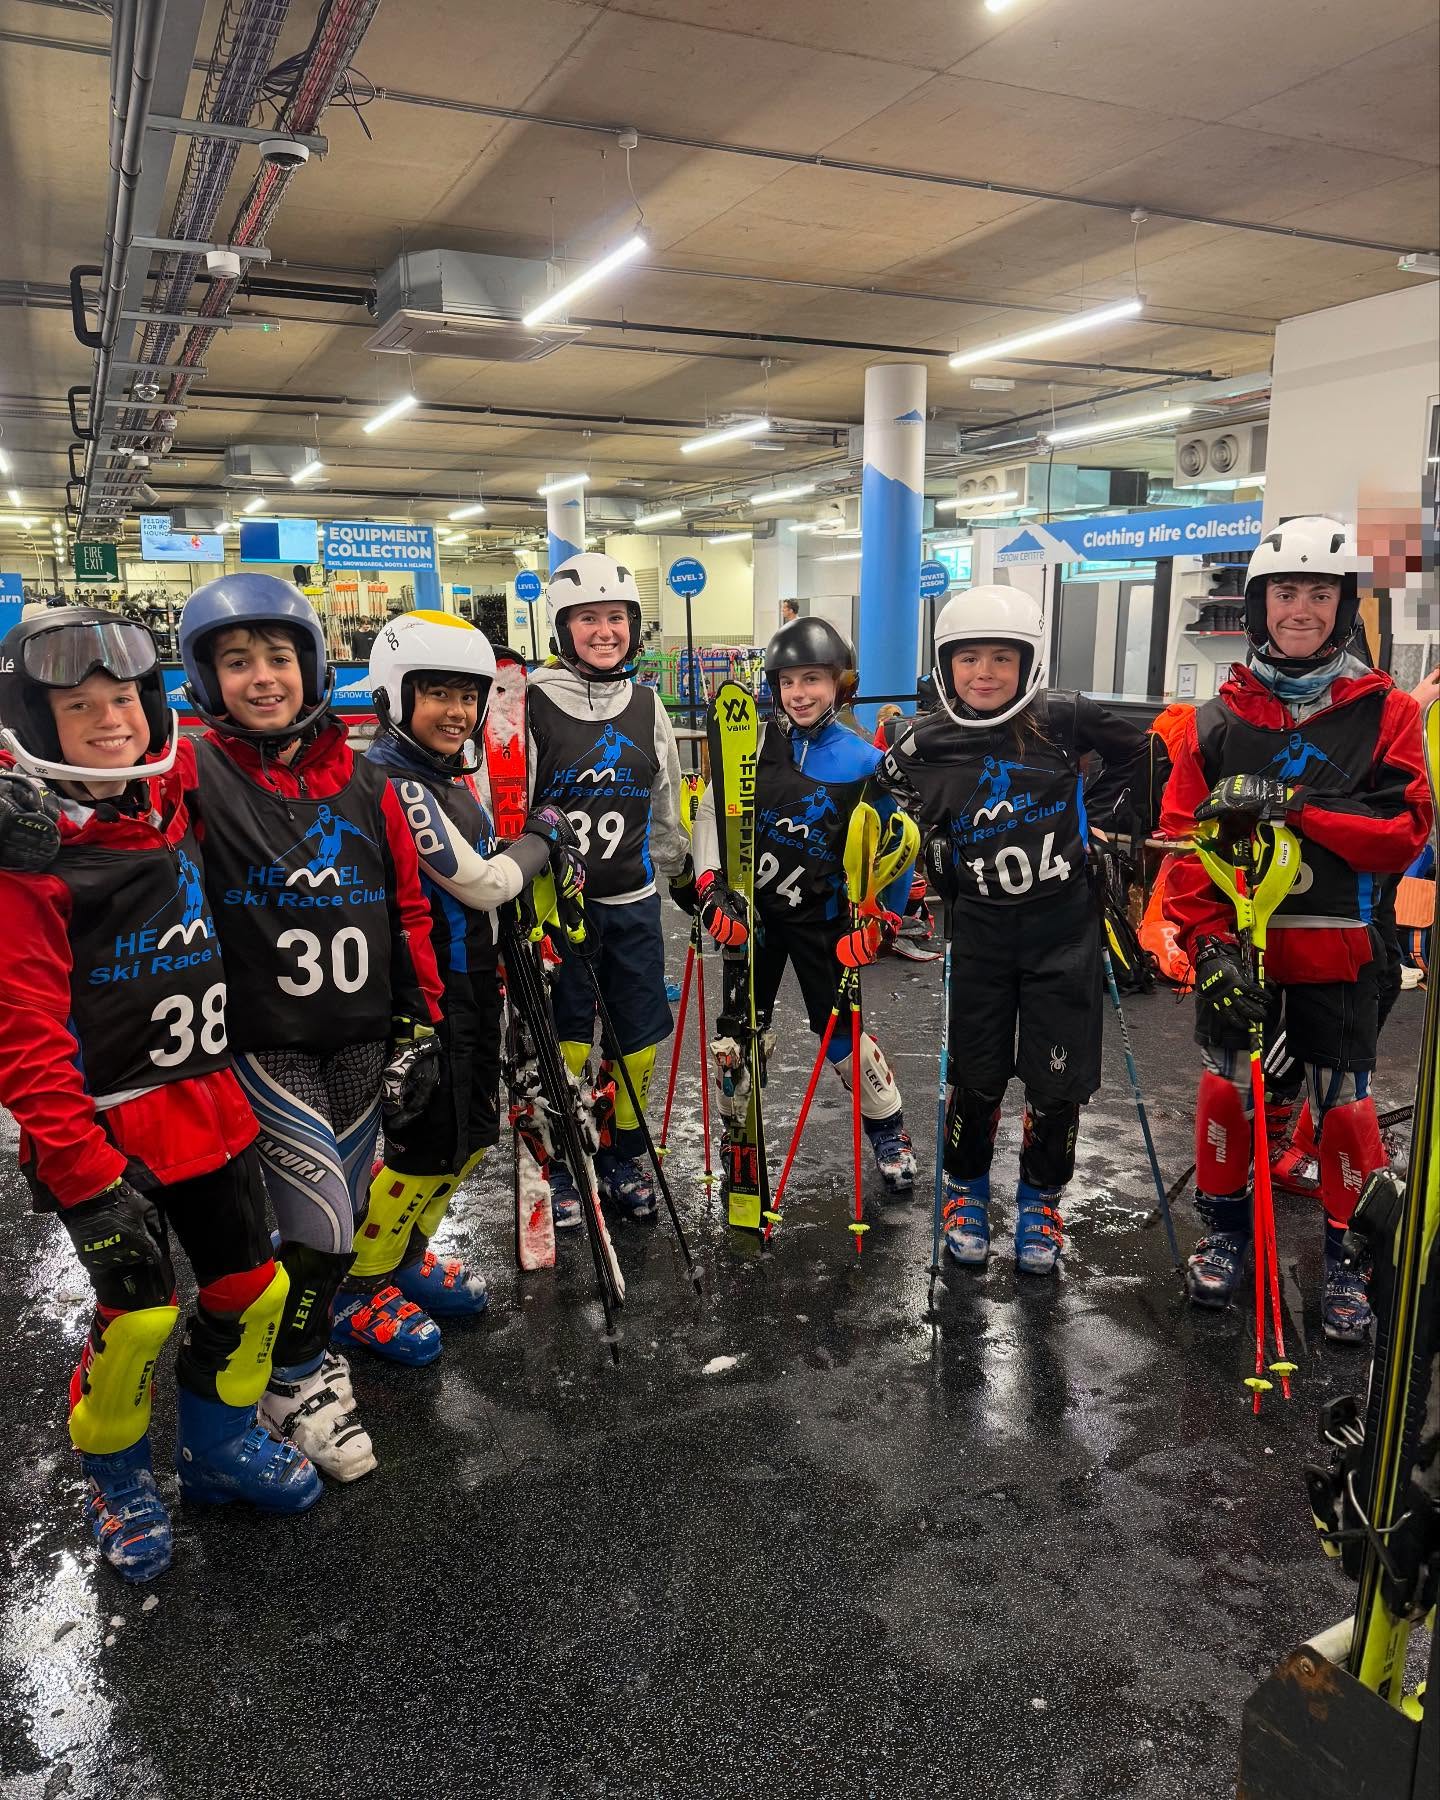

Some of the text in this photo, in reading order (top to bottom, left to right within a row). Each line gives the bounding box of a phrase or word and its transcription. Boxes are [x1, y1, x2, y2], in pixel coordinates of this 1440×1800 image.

[329, 527, 428, 543] EQUIPMENT
[1083, 515, 1262, 548] Clothing Hire Collectio
[84, 547, 102, 558] FIRE
[327, 543, 432, 559] COLLECTION
[84, 559, 103, 569] EXIT
[672, 573, 697, 582] LEVEL
[920, 572, 944, 581] RIVATE
[0, 594, 21, 603] urn
[553, 767, 635, 785] HEMEL
[569, 786, 614, 797] Race
[619, 785, 651, 799] Club
[727, 803, 740, 815] SL
[952, 791, 1038, 834] HEMEL
[17, 818, 48, 831] LEKI
[973, 819, 1018, 843] Race
[1024, 800, 1068, 824] Club
[966, 831, 1072, 897] 104
[248, 865, 364, 888] HEMEL
[754, 852, 808, 908] 94
[223, 886, 386, 908] Ski Race Club
[115, 915, 217, 958] HEME
[88, 960, 140, 985] Ski
[151, 947, 212, 975] Race
[276, 926, 369, 997] 30
[1201, 969, 1224, 991] LEKI
[149, 982, 228, 1067] 38
[865, 1068, 883, 1093] LEKI
[951, 1114, 964, 1149] LEKI
[255, 1135, 328, 1183] IAPURA
[391, 1191, 425, 1235] LEKI
[83, 1233, 122, 1252] LEKI
[292, 1289, 317, 1330] LEKI
[333, 1299, 364, 1328] ANGE
